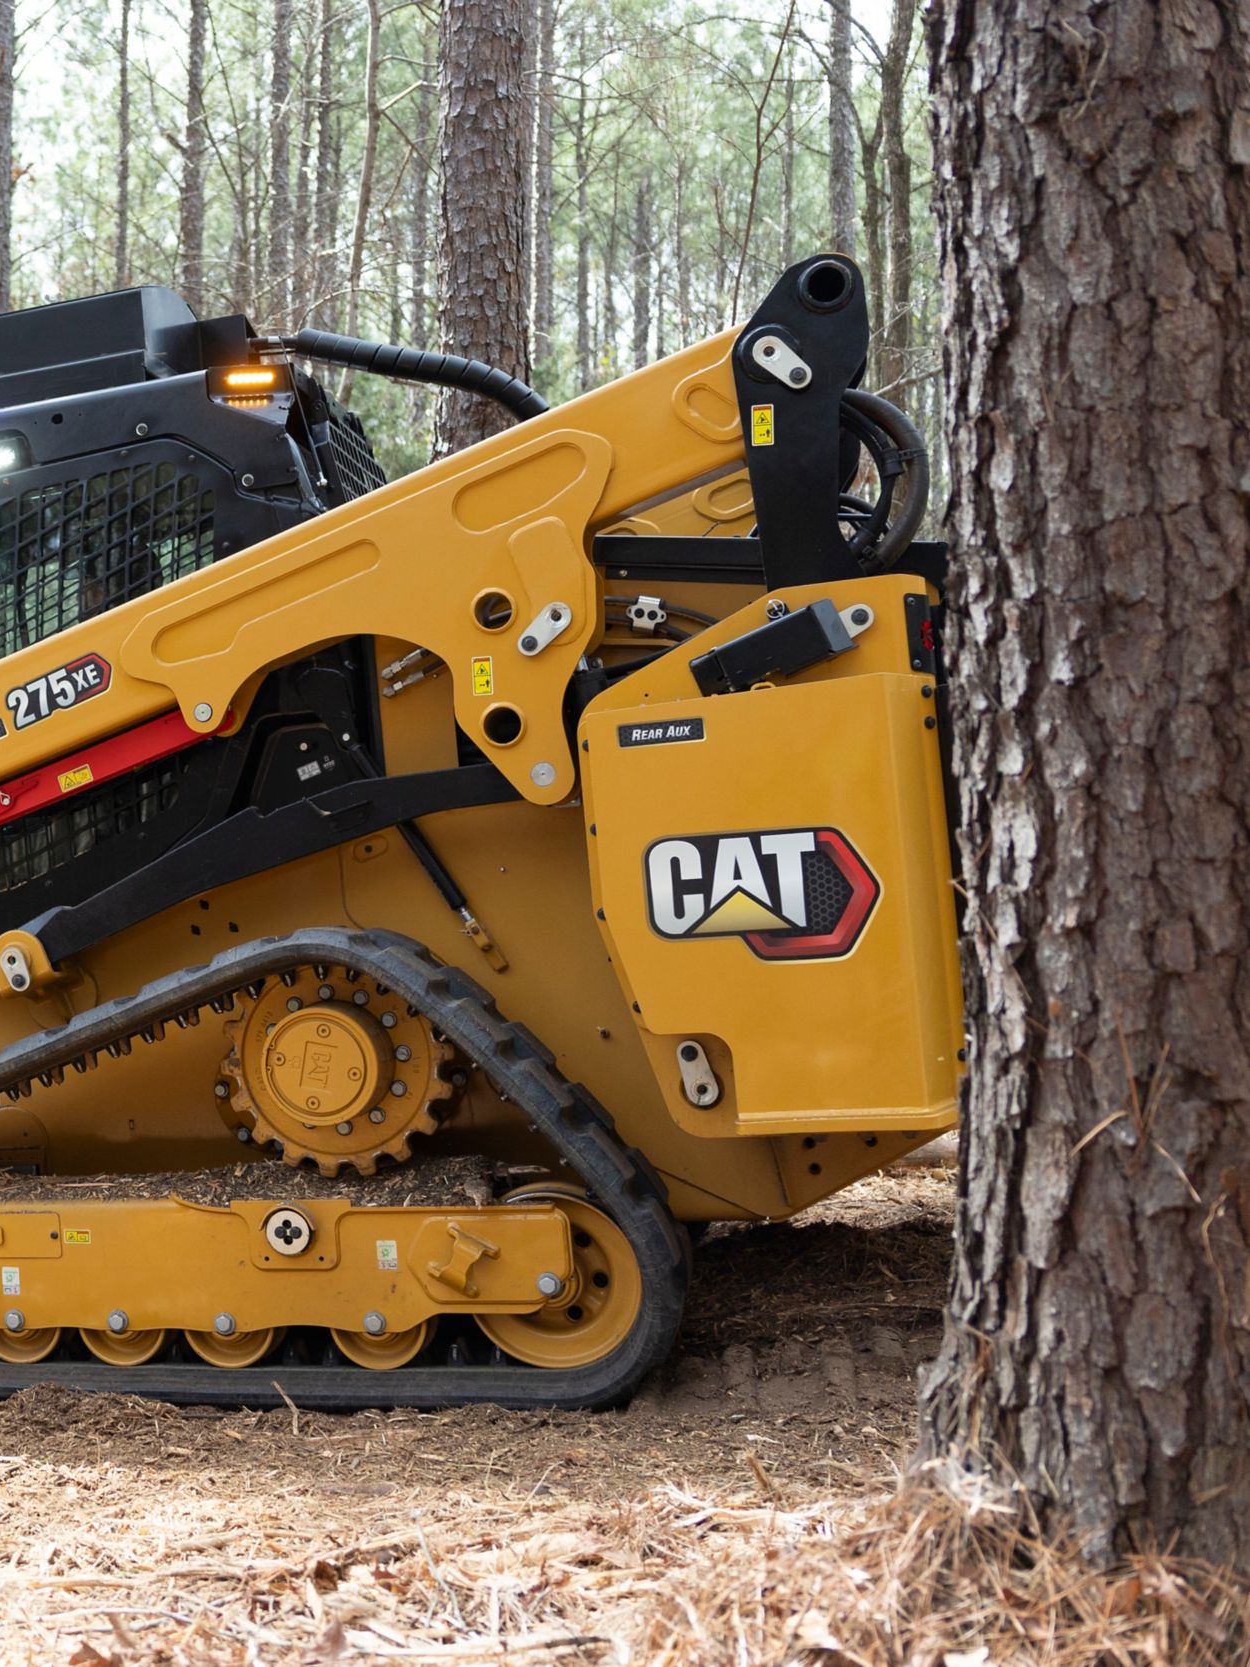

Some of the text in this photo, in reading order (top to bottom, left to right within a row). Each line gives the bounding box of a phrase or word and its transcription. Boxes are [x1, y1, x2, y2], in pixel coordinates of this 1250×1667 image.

[7, 664, 100, 728] 275XE
[632, 726, 691, 741] REAR AUX
[648, 831, 816, 935] CAT
